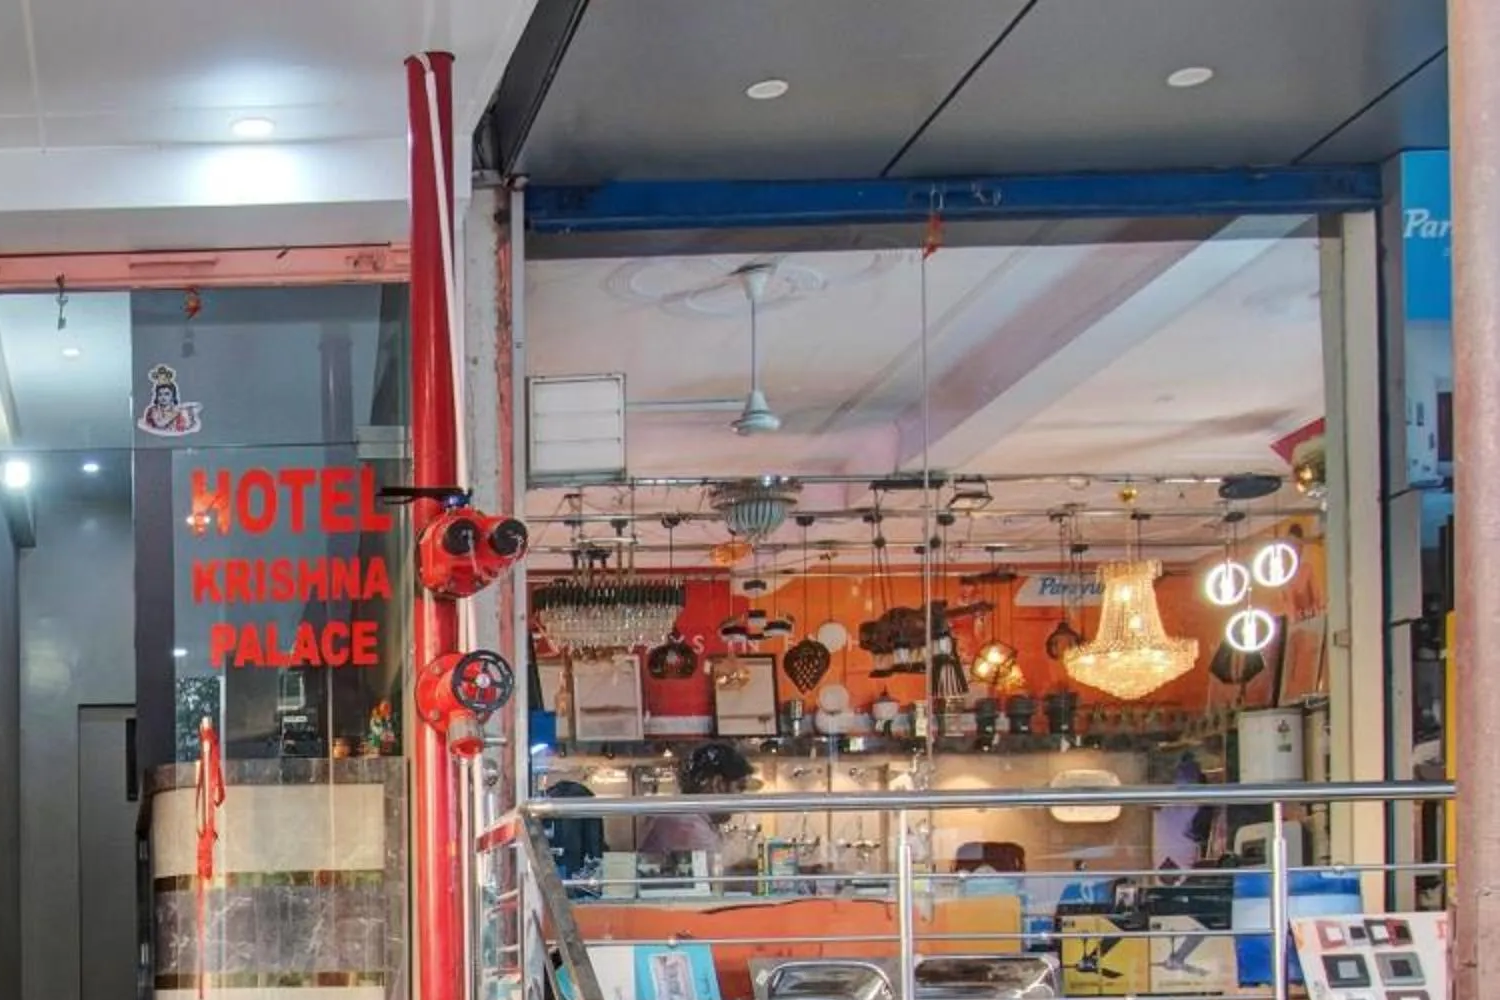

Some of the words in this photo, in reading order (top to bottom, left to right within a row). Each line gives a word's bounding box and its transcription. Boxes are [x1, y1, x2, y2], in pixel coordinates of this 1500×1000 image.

[189, 464, 393, 536] HOTEL
[191, 556, 393, 603] KRISHNA
[211, 620, 379, 667] PALACE
